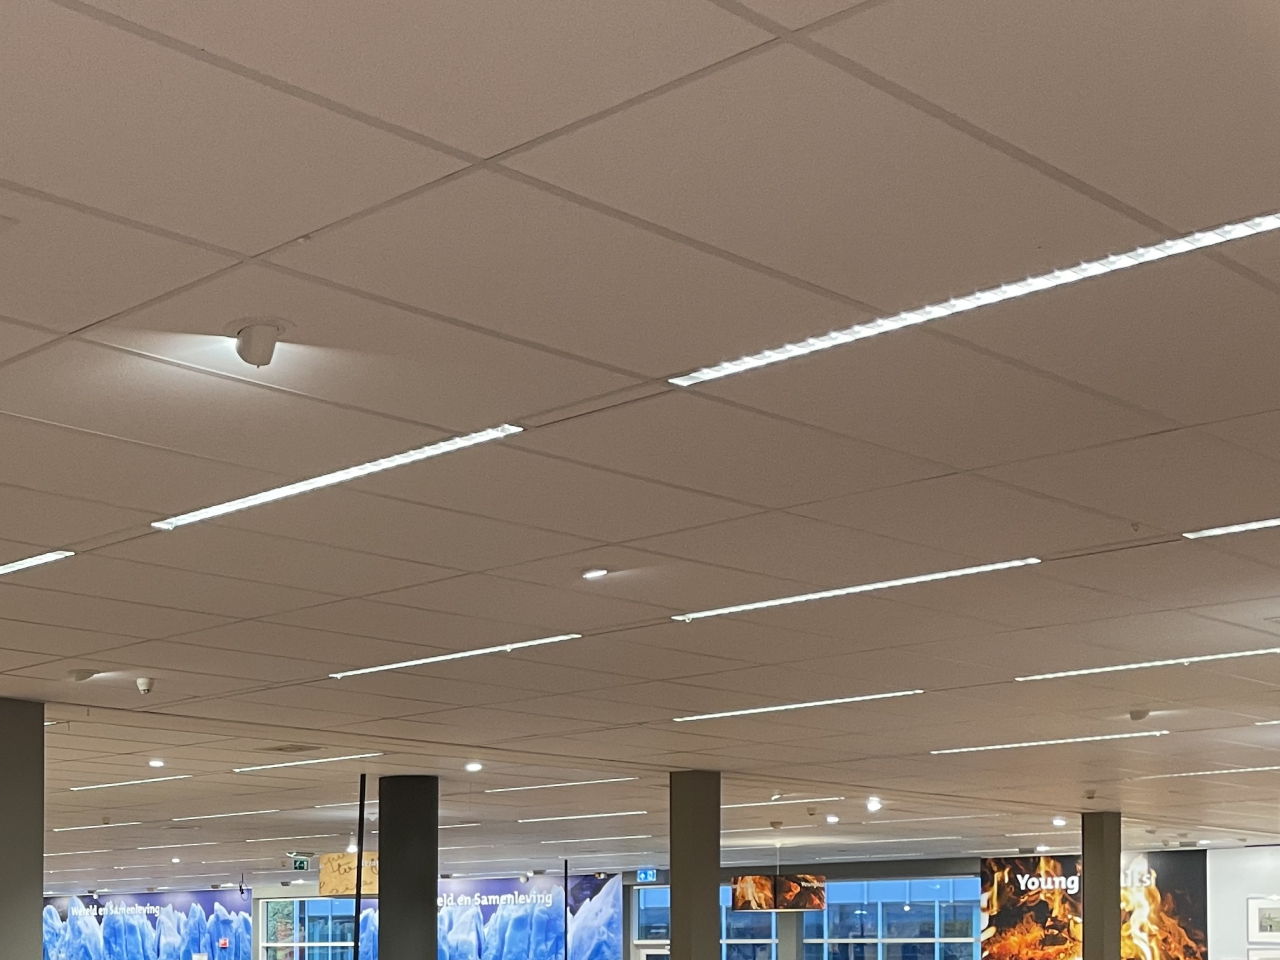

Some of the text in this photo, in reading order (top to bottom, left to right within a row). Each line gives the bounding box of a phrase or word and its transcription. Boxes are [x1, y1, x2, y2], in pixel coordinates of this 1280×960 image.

[1016, 873, 1080, 895] Young
[437, 890, 553, 908] eld en Samenleving
[71, 903, 160, 917] Wereld en Samenleving
